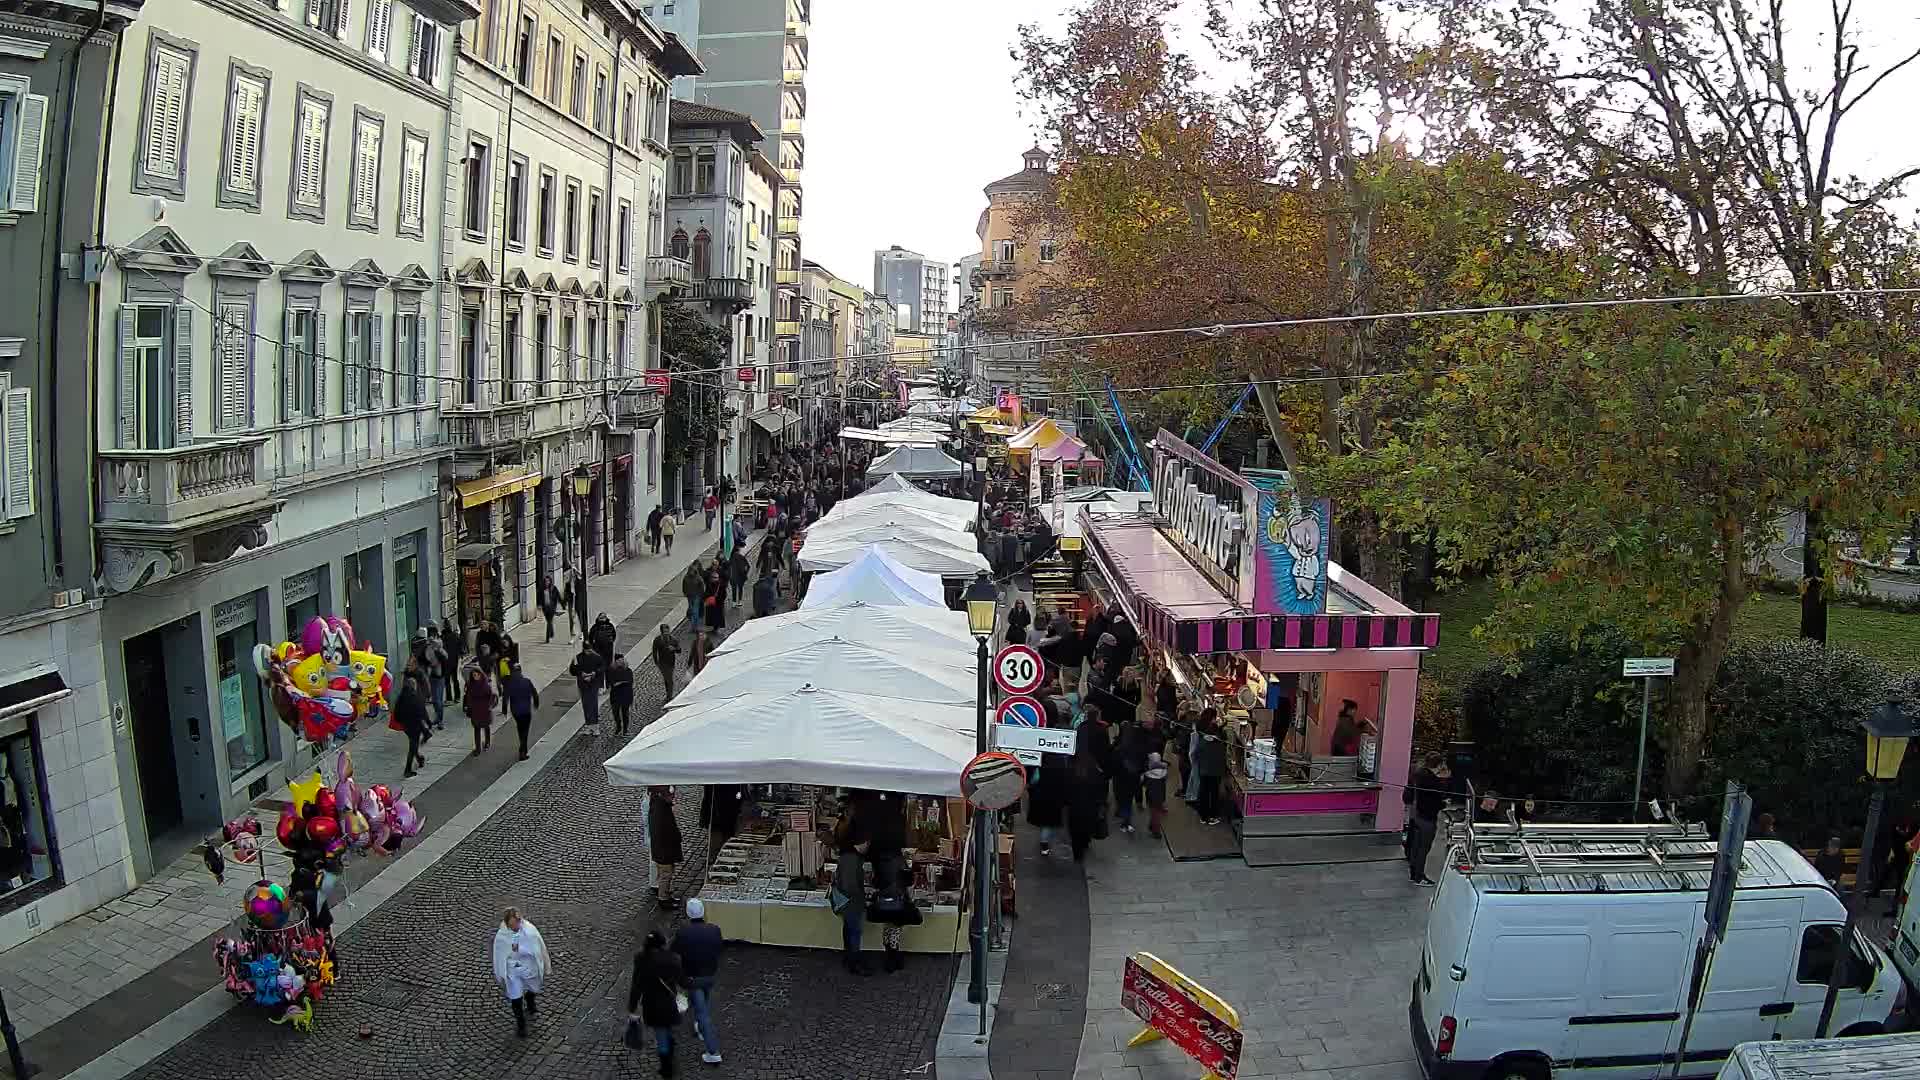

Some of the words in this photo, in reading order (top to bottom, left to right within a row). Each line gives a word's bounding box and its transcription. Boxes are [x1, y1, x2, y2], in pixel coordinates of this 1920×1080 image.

[1005, 659, 1033, 680] 30
[1038, 738, 1069, 748] Dante
[1190, 1017, 1234, 1051] Calde
